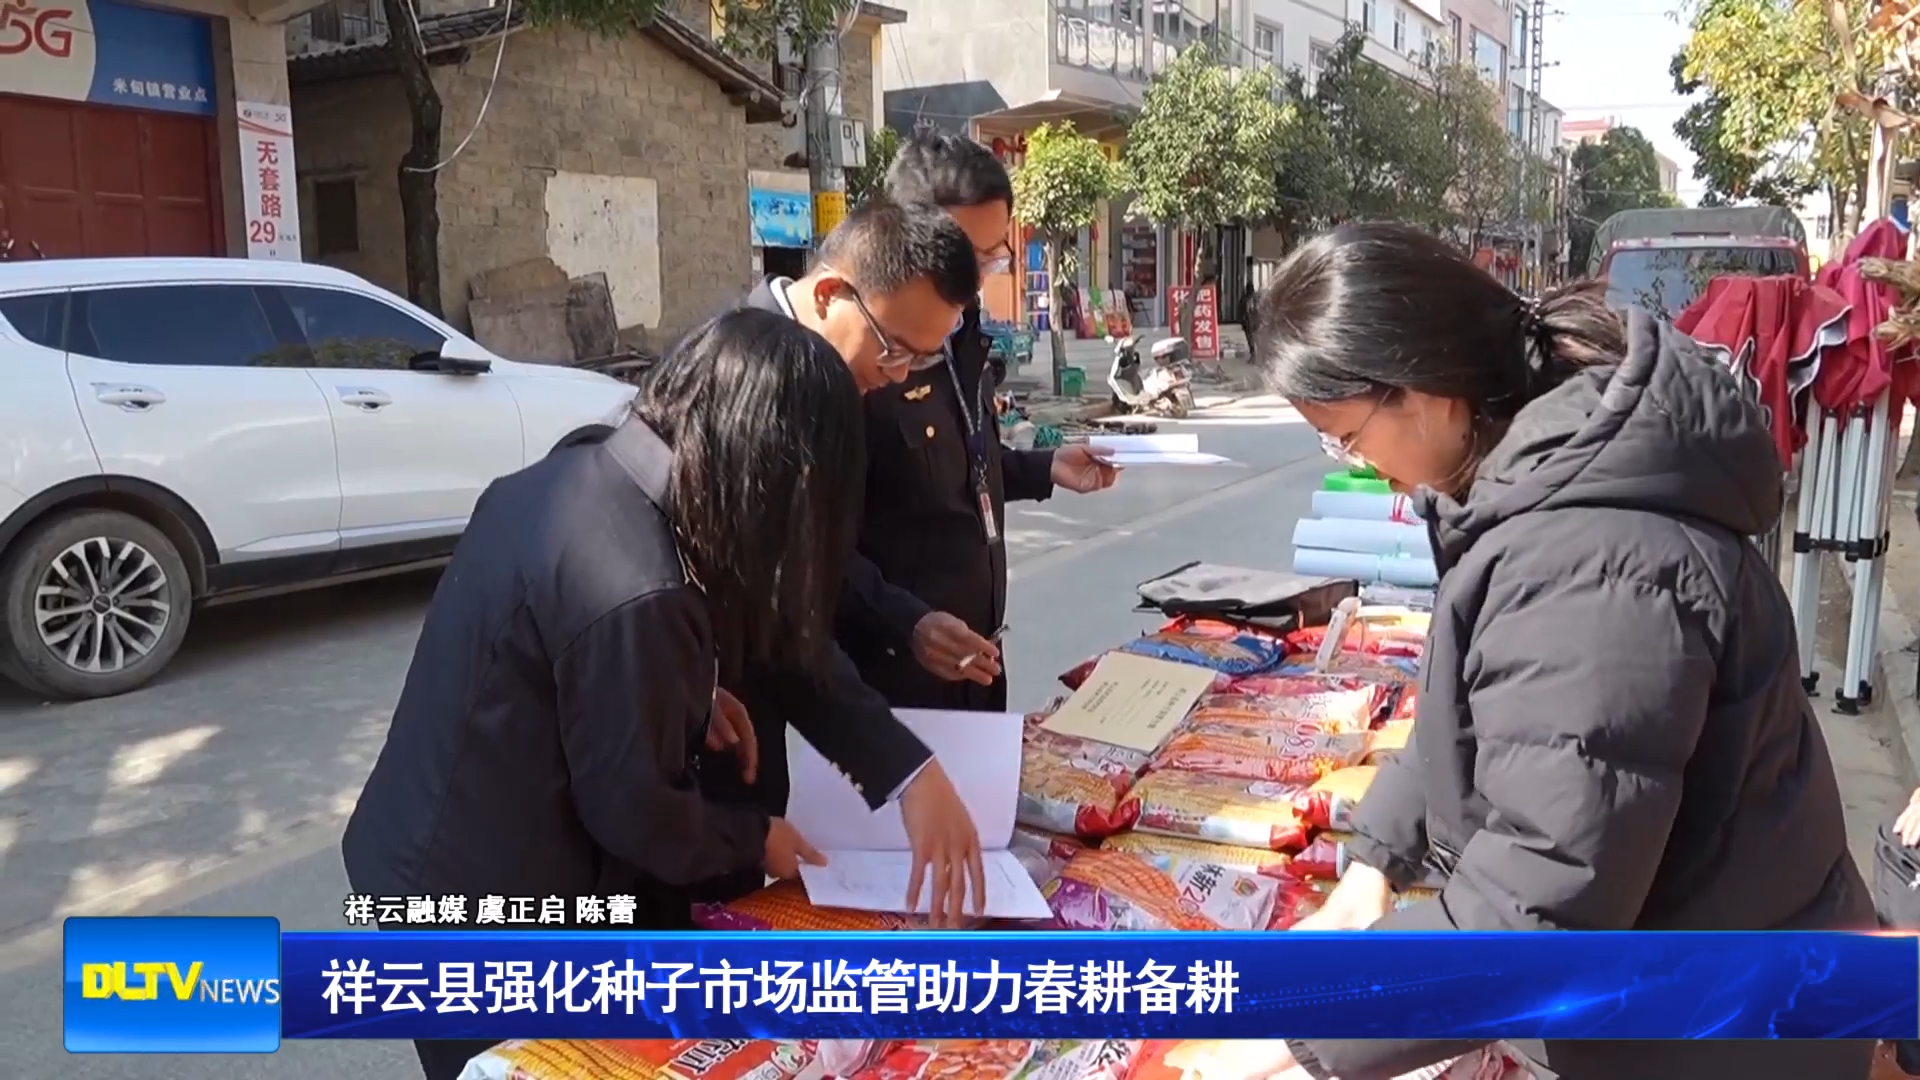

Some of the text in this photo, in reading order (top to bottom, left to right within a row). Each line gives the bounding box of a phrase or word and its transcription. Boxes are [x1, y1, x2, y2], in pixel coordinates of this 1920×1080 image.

[0, 9, 73, 58] 5G
[112, 77, 208, 104] 米甸镇营业点
[257, 140, 282, 219] 无套路
[250, 220, 276, 244] 29
